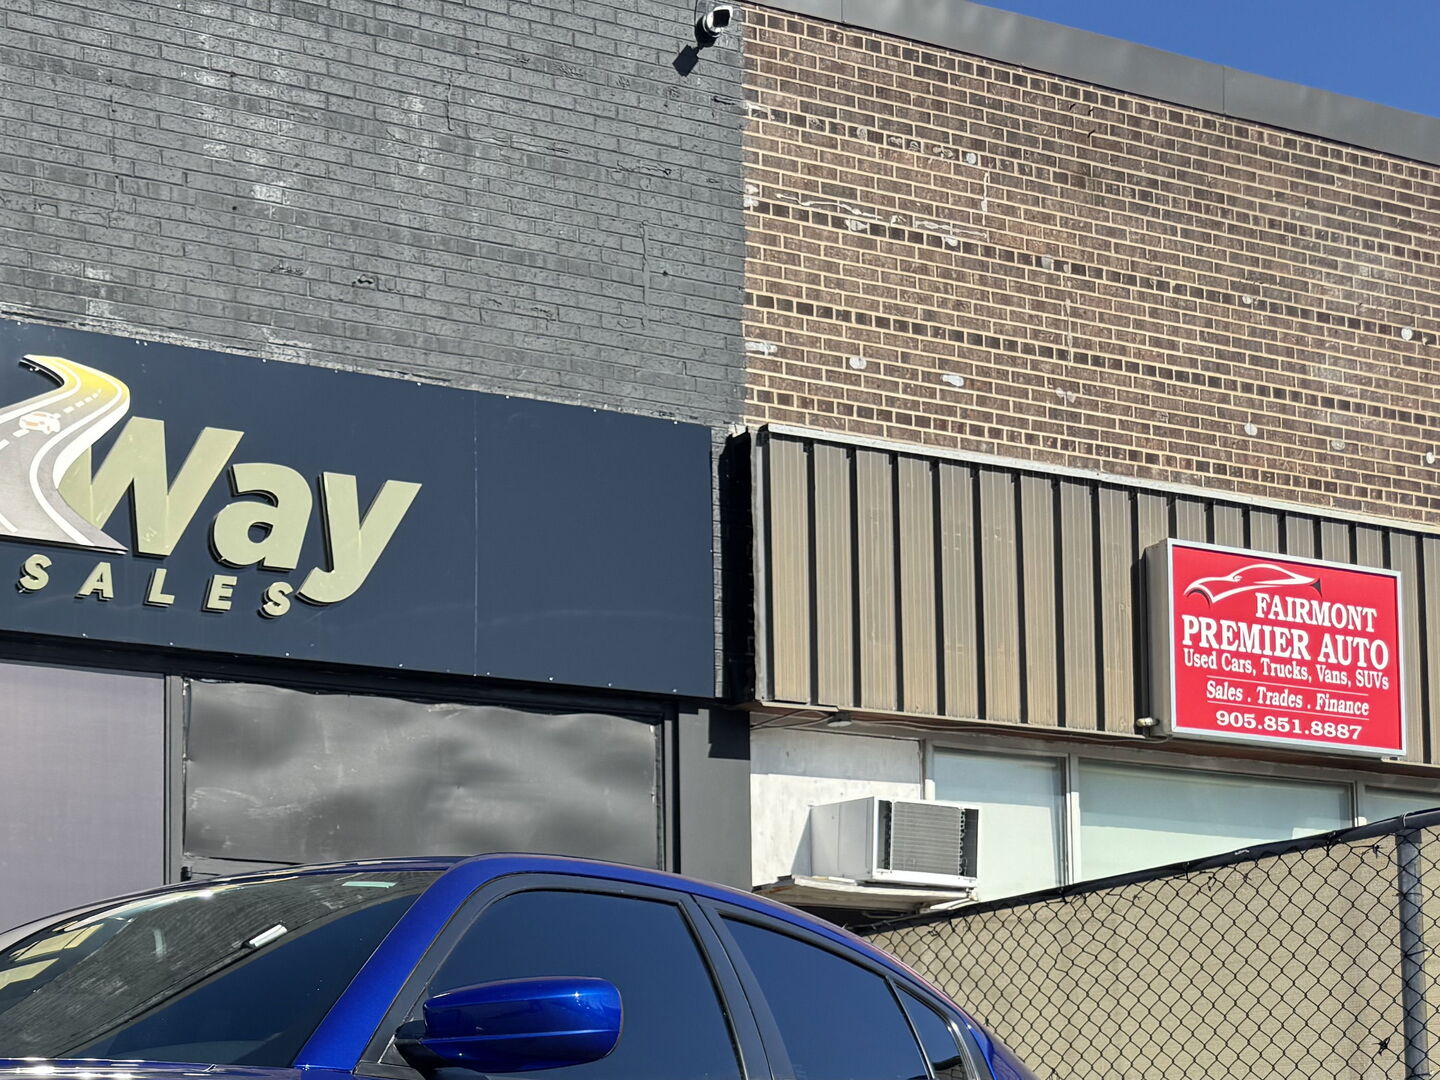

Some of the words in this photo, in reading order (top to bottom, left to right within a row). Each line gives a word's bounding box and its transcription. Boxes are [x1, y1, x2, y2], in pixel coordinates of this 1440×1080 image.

[18, 554, 293, 618] SALES
[1255, 592, 1377, 632] FAIRMONT
[1181, 614, 1311, 661] PREMIER
[1317, 633, 1389, 670] AUTO
[1183, 648, 1217, 670] Used
[1221, 652, 1256, 676] Cars,
[1260, 657, 1312, 683] Trucks,
[1315, 664, 1351, 687] Vans,
[1355, 670, 1389, 690] SUVs
[1206, 681, 1243, 702] Sales
[1257, 687, 1303, 709] Trades
[1315, 693, 1369, 715] Finance
[1216, 711, 1362, 740] 905.851.8887
